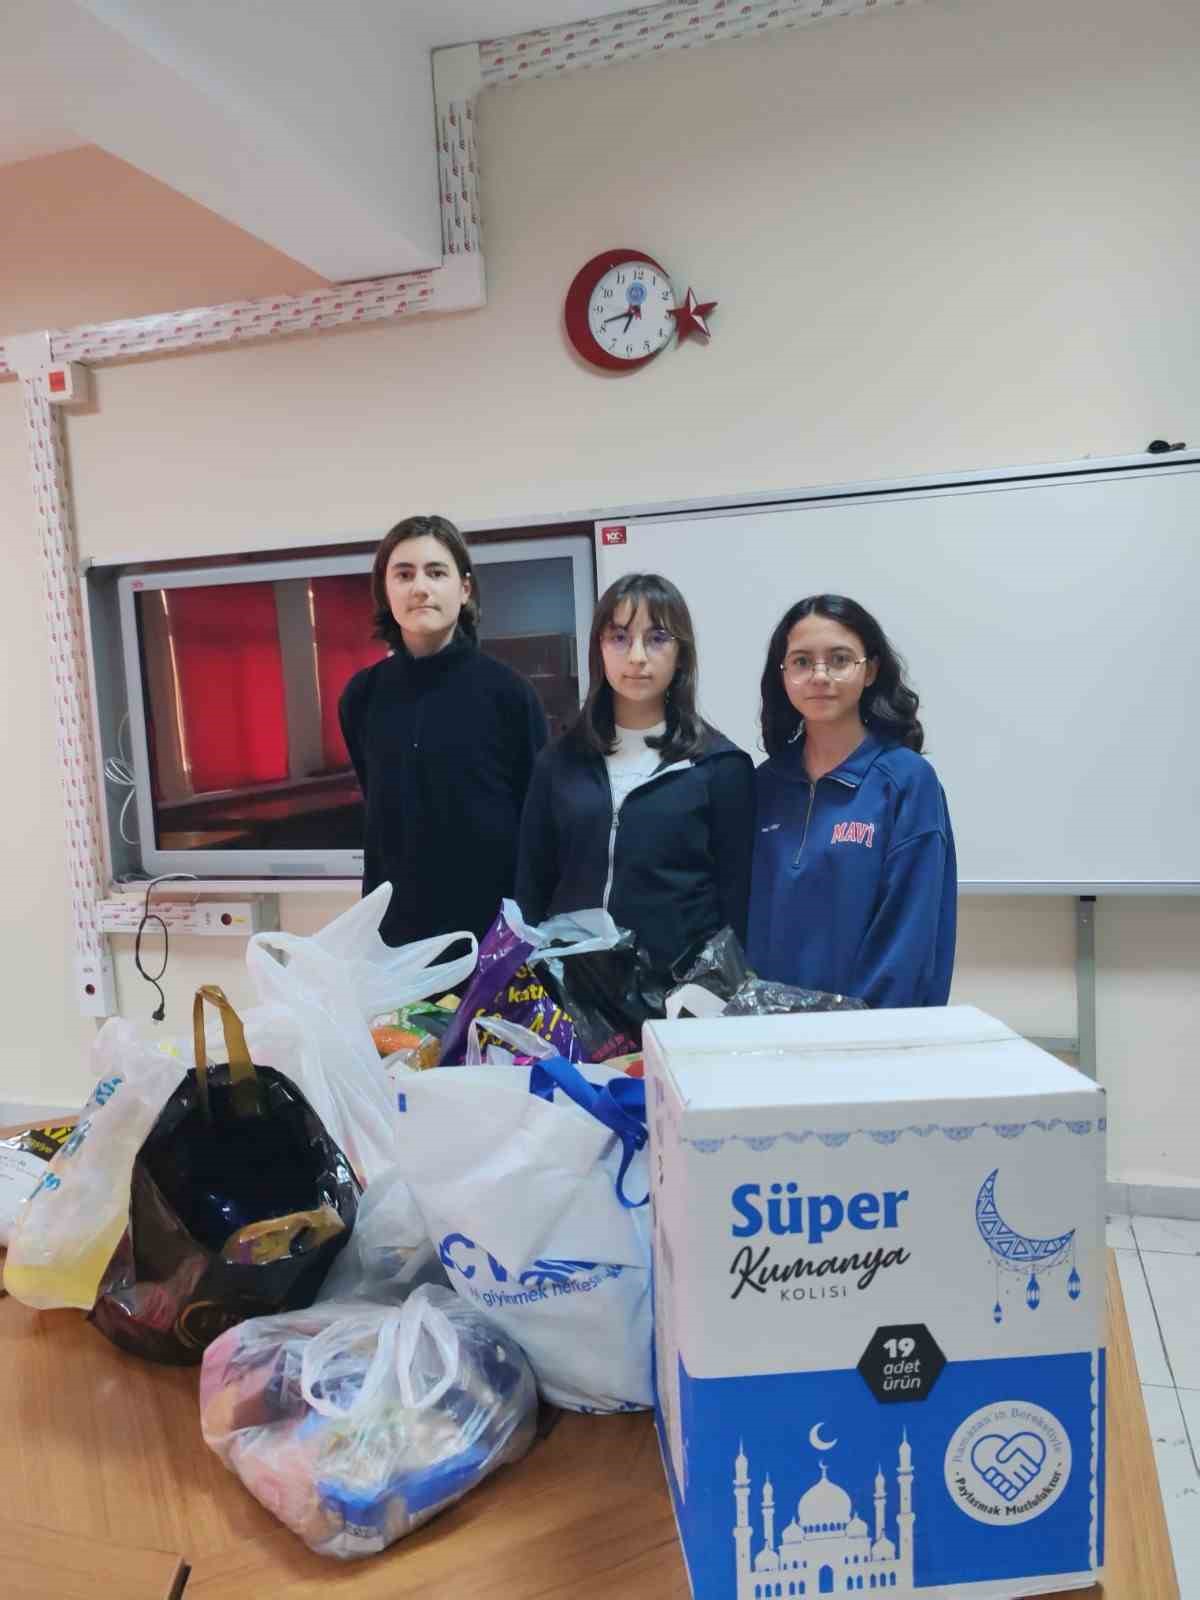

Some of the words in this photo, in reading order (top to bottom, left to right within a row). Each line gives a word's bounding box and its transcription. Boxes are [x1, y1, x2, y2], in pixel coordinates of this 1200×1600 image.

[616, 271, 626, 285] 11
[632, 270, 644, 281] 12
[601, 288, 613, 298] 10
[661, 290, 671, 301] 2
[731, 1182, 909, 1244] Süper
[729, 1246, 911, 1300] Kumanya
[482, 1284, 549, 1307] giyinmek
[883, 1337, 916, 1359] 19
[883, 1359, 921, 1376] adet
[883, 1375, 921, 1391] ürün
